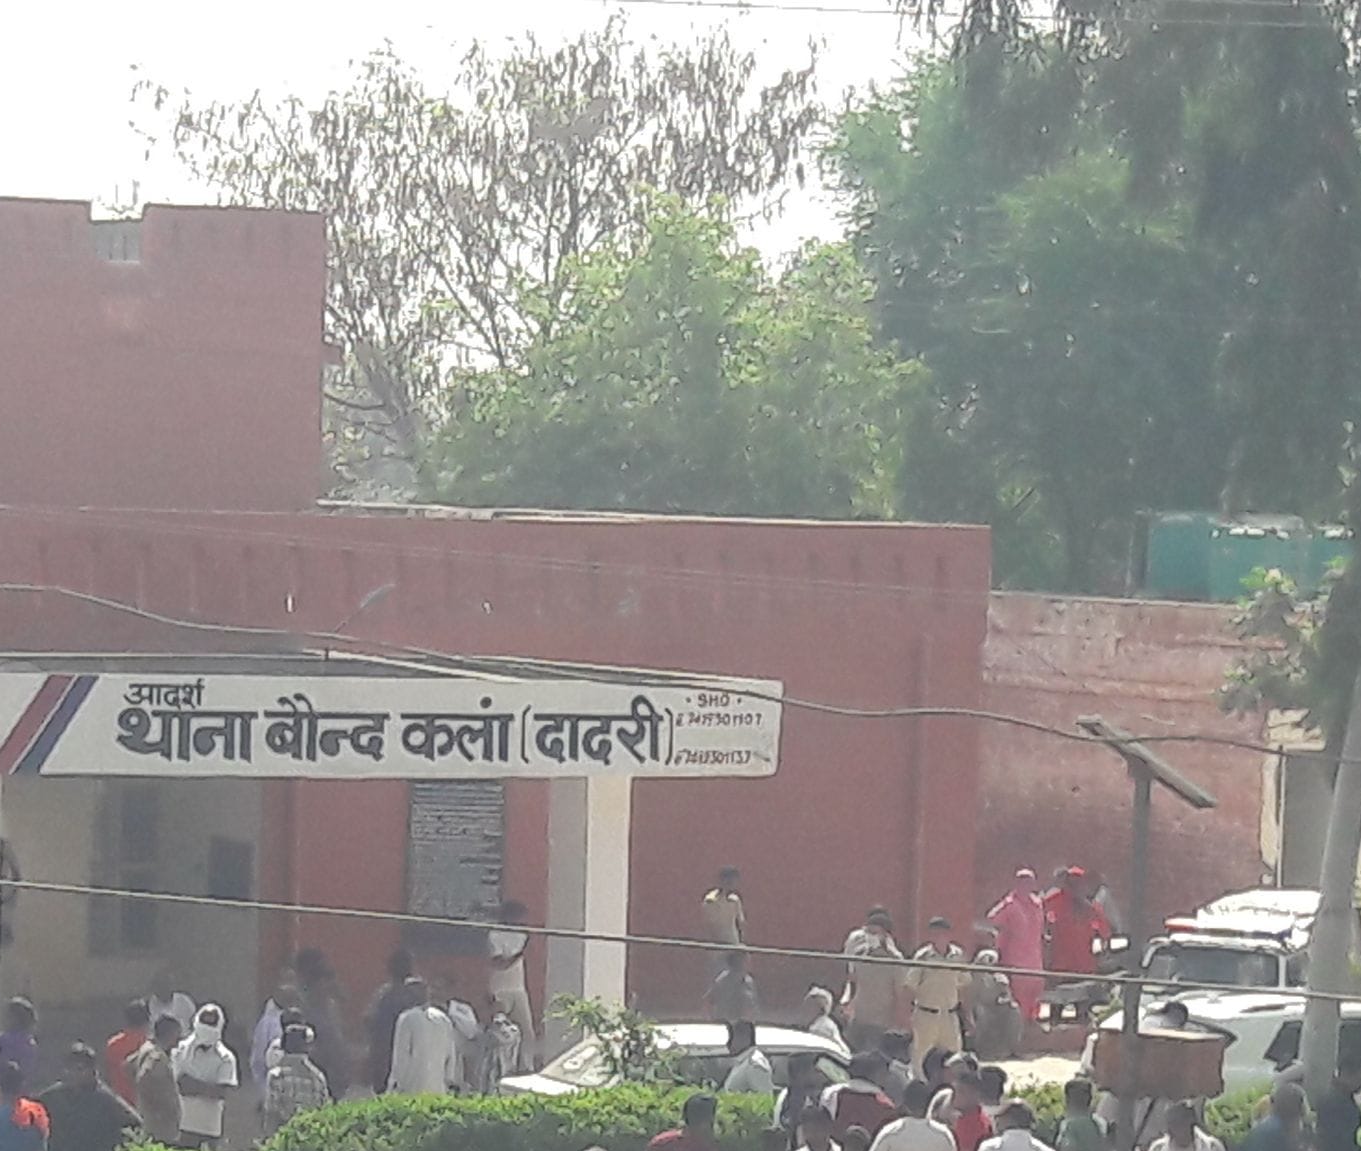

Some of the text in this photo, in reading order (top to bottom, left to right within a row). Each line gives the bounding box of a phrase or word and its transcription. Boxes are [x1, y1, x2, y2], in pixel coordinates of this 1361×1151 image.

[123, 678, 205, 709] आदर्श
[115, 707, 259, 763] थाना
[400, 696, 515, 763] कलां
[521, 694, 674, 766] (दादरी)
